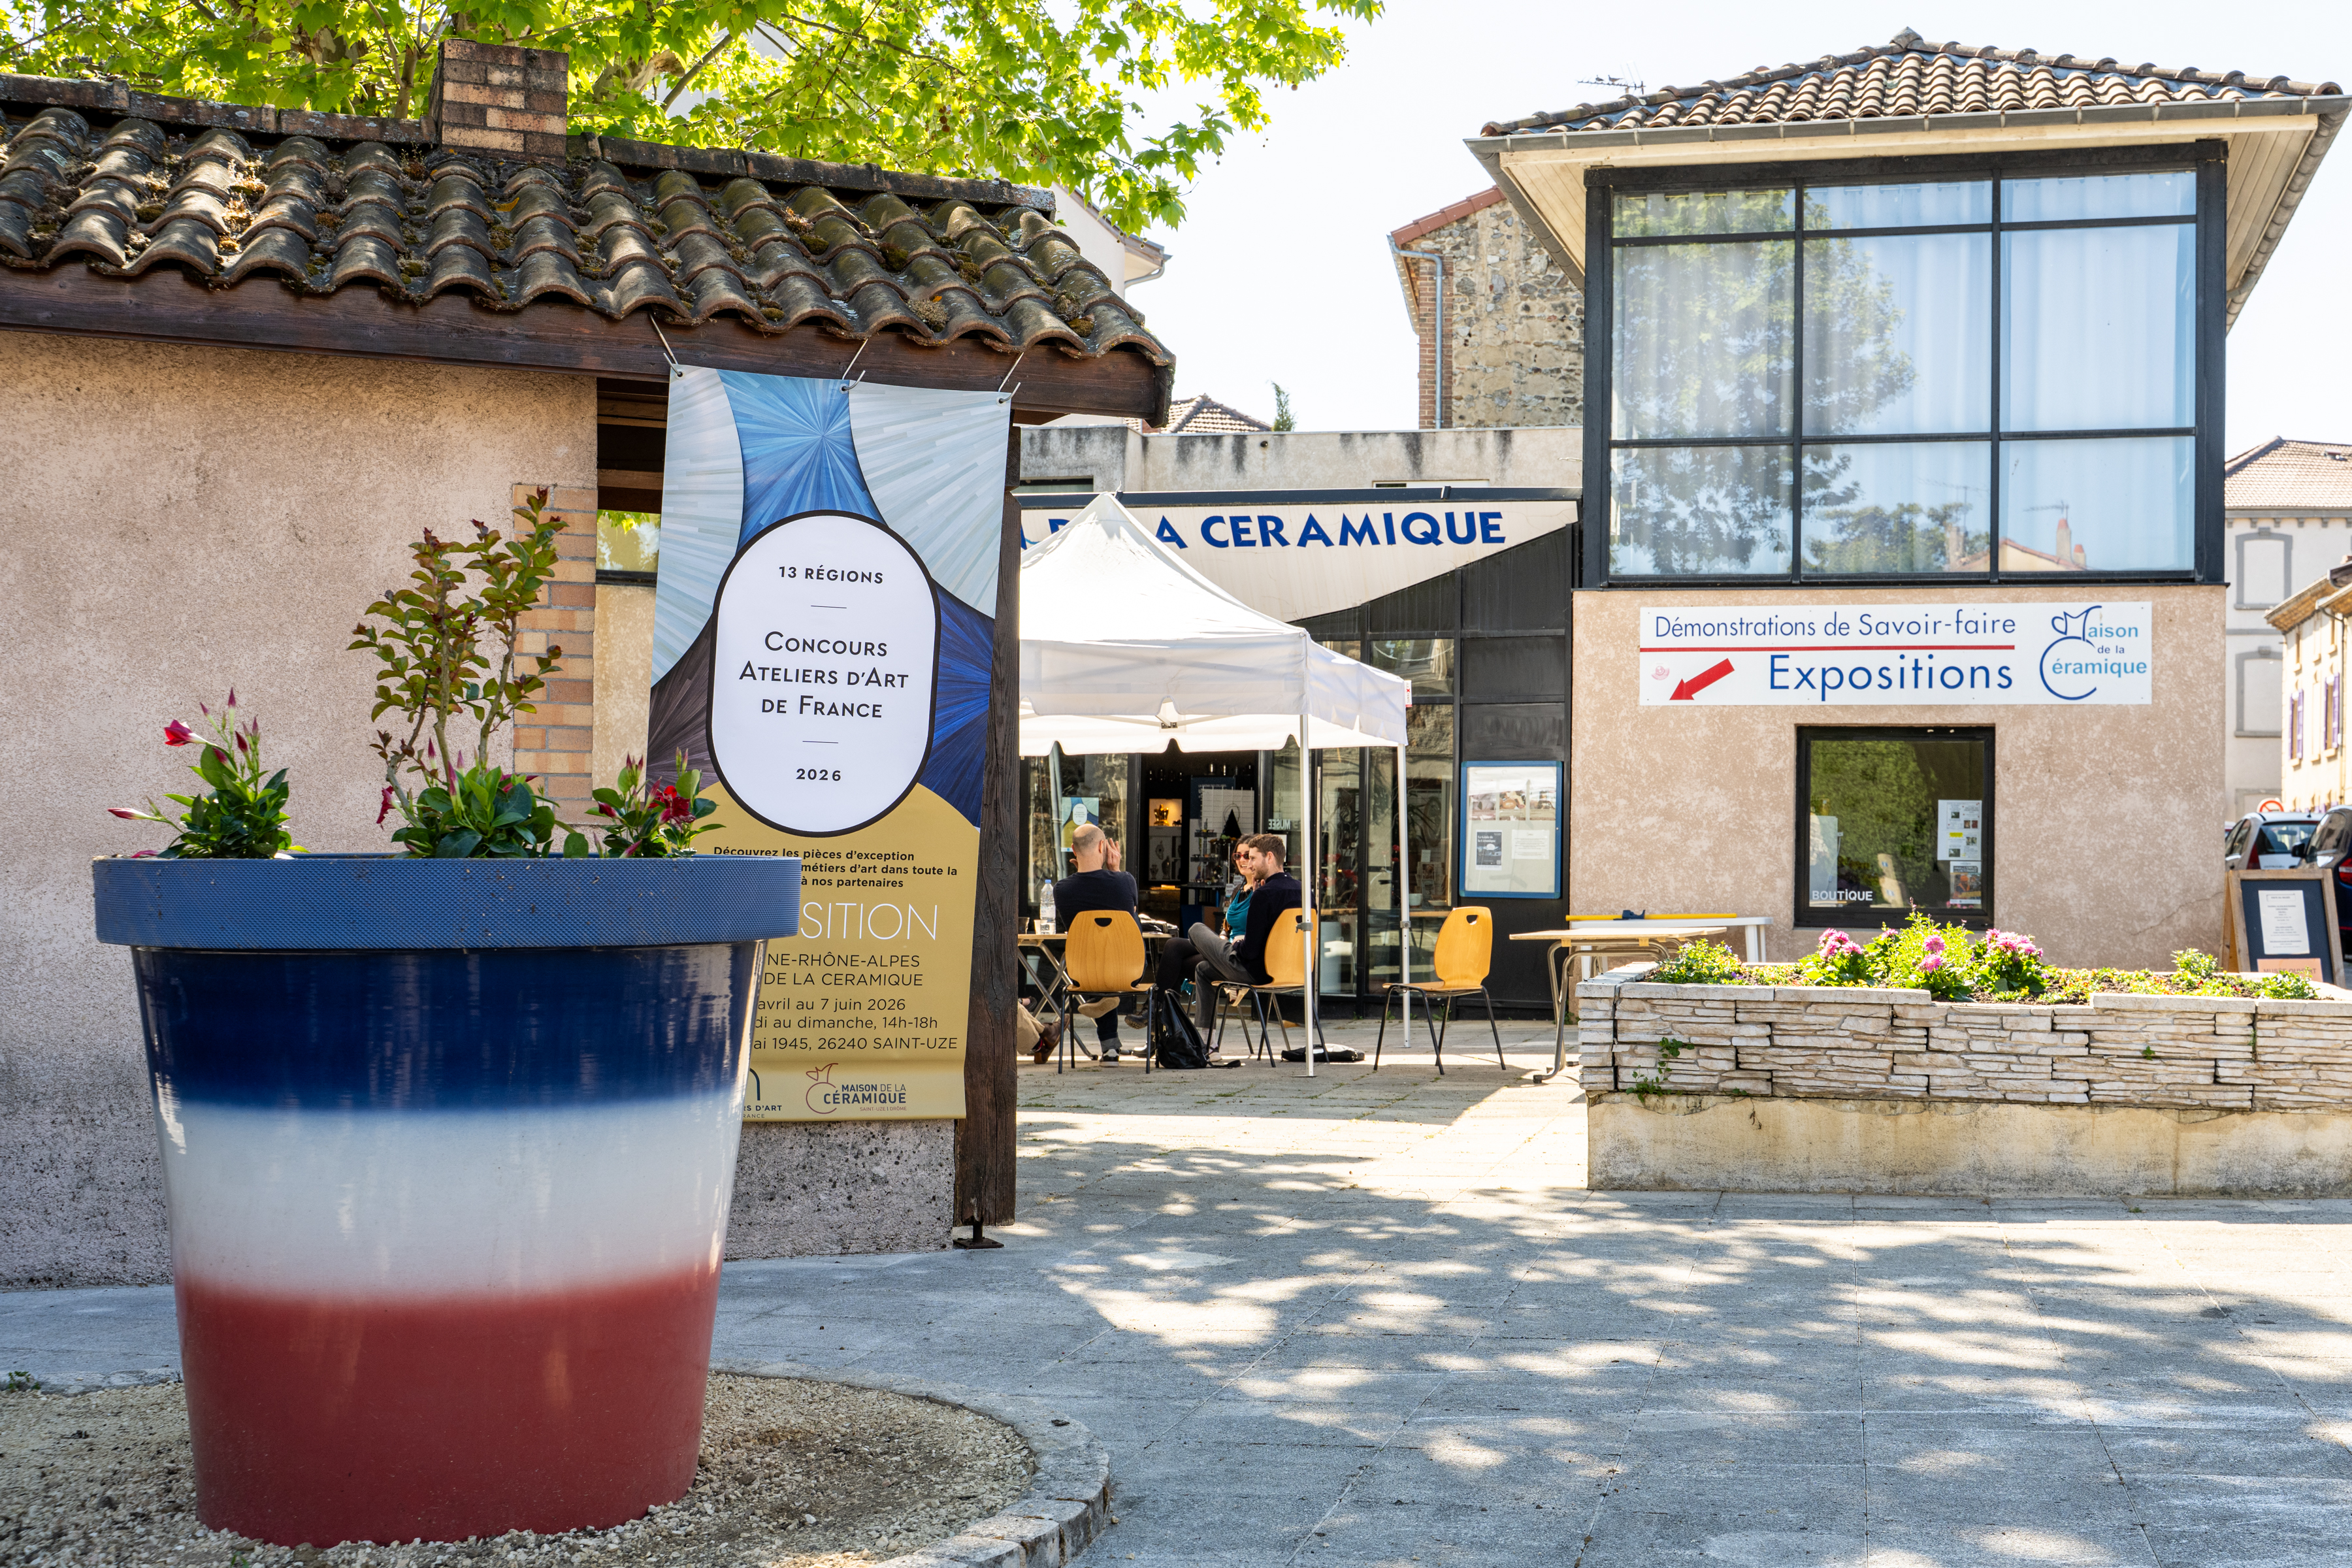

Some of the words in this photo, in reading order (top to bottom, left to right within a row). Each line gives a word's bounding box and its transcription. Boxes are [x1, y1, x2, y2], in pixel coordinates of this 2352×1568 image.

[1155, 515, 1188, 549] A
[1200, 511, 1507, 549] CERAMIQUE
[779, 566, 797, 578] 13
[804, 564, 883, 584] RÉGIONS
[1656, 615, 1816, 638] Démonstrations
[1824, 611, 1850, 636] de
[1859, 609, 2016, 636] Savoir-faire
[764, 630, 888, 657] CONCOURS
[2097, 645, 2111, 654] de
[2115, 645, 2125, 654] la
[739, 661, 838, 685] ATELIERS
[847, 666, 909, 688] D'ART
[1770, 653, 2013, 702] Expositions
[761, 698, 787, 714] DE
[799, 695, 883, 718] FRANCE
[796, 768, 841, 781] 2026
[713, 847, 778, 857] Découvrez
[782, 848, 799, 857] les
[803, 849, 842, 860] pièces
[845, 850, 915, 862] d'exception
[801, 863, 846, 873] métiers
[850, 864, 877, 874] d'art
[881, 865, 909, 875] dans
[913, 866, 943, 875] toute
[947, 866, 958, 875] la
[837, 878, 904, 888] partenaires
[1812, 889, 1873, 901] BOUTIQUE
[800, 901, 938, 941] SITION
[768, 951, 921, 967] NE-RHÔNE-ALPES
[764, 973, 787, 985] DE
[793, 973, 815, 985] LA
[821, 973, 923, 987] CERAMIQUE
[758, 998, 791, 1010] avril
[796, 1001, 815, 1011] au
[821, 998, 829, 1010] 7
[834, 999, 862, 1013] juin
[867, 999, 906, 1011] 2026
[773, 1019, 791, 1028] au
[797, 1016, 877, 1030] dimanche,
[882, 1017, 938, 1029] 14h-18h
[753, 1037, 766, 1049] ai
[772, 1037, 812, 1051] 1945,
[817, 1037, 868, 1050] 26240
[873, 1037, 958, 1050] SAINT-UZE
[841, 1084, 877, 1092] MAISON
[880, 1083, 892, 1092] DE
[894, 1083, 907, 1092] LA
[823, 1090, 907, 1104] CÉRAMIQUE
